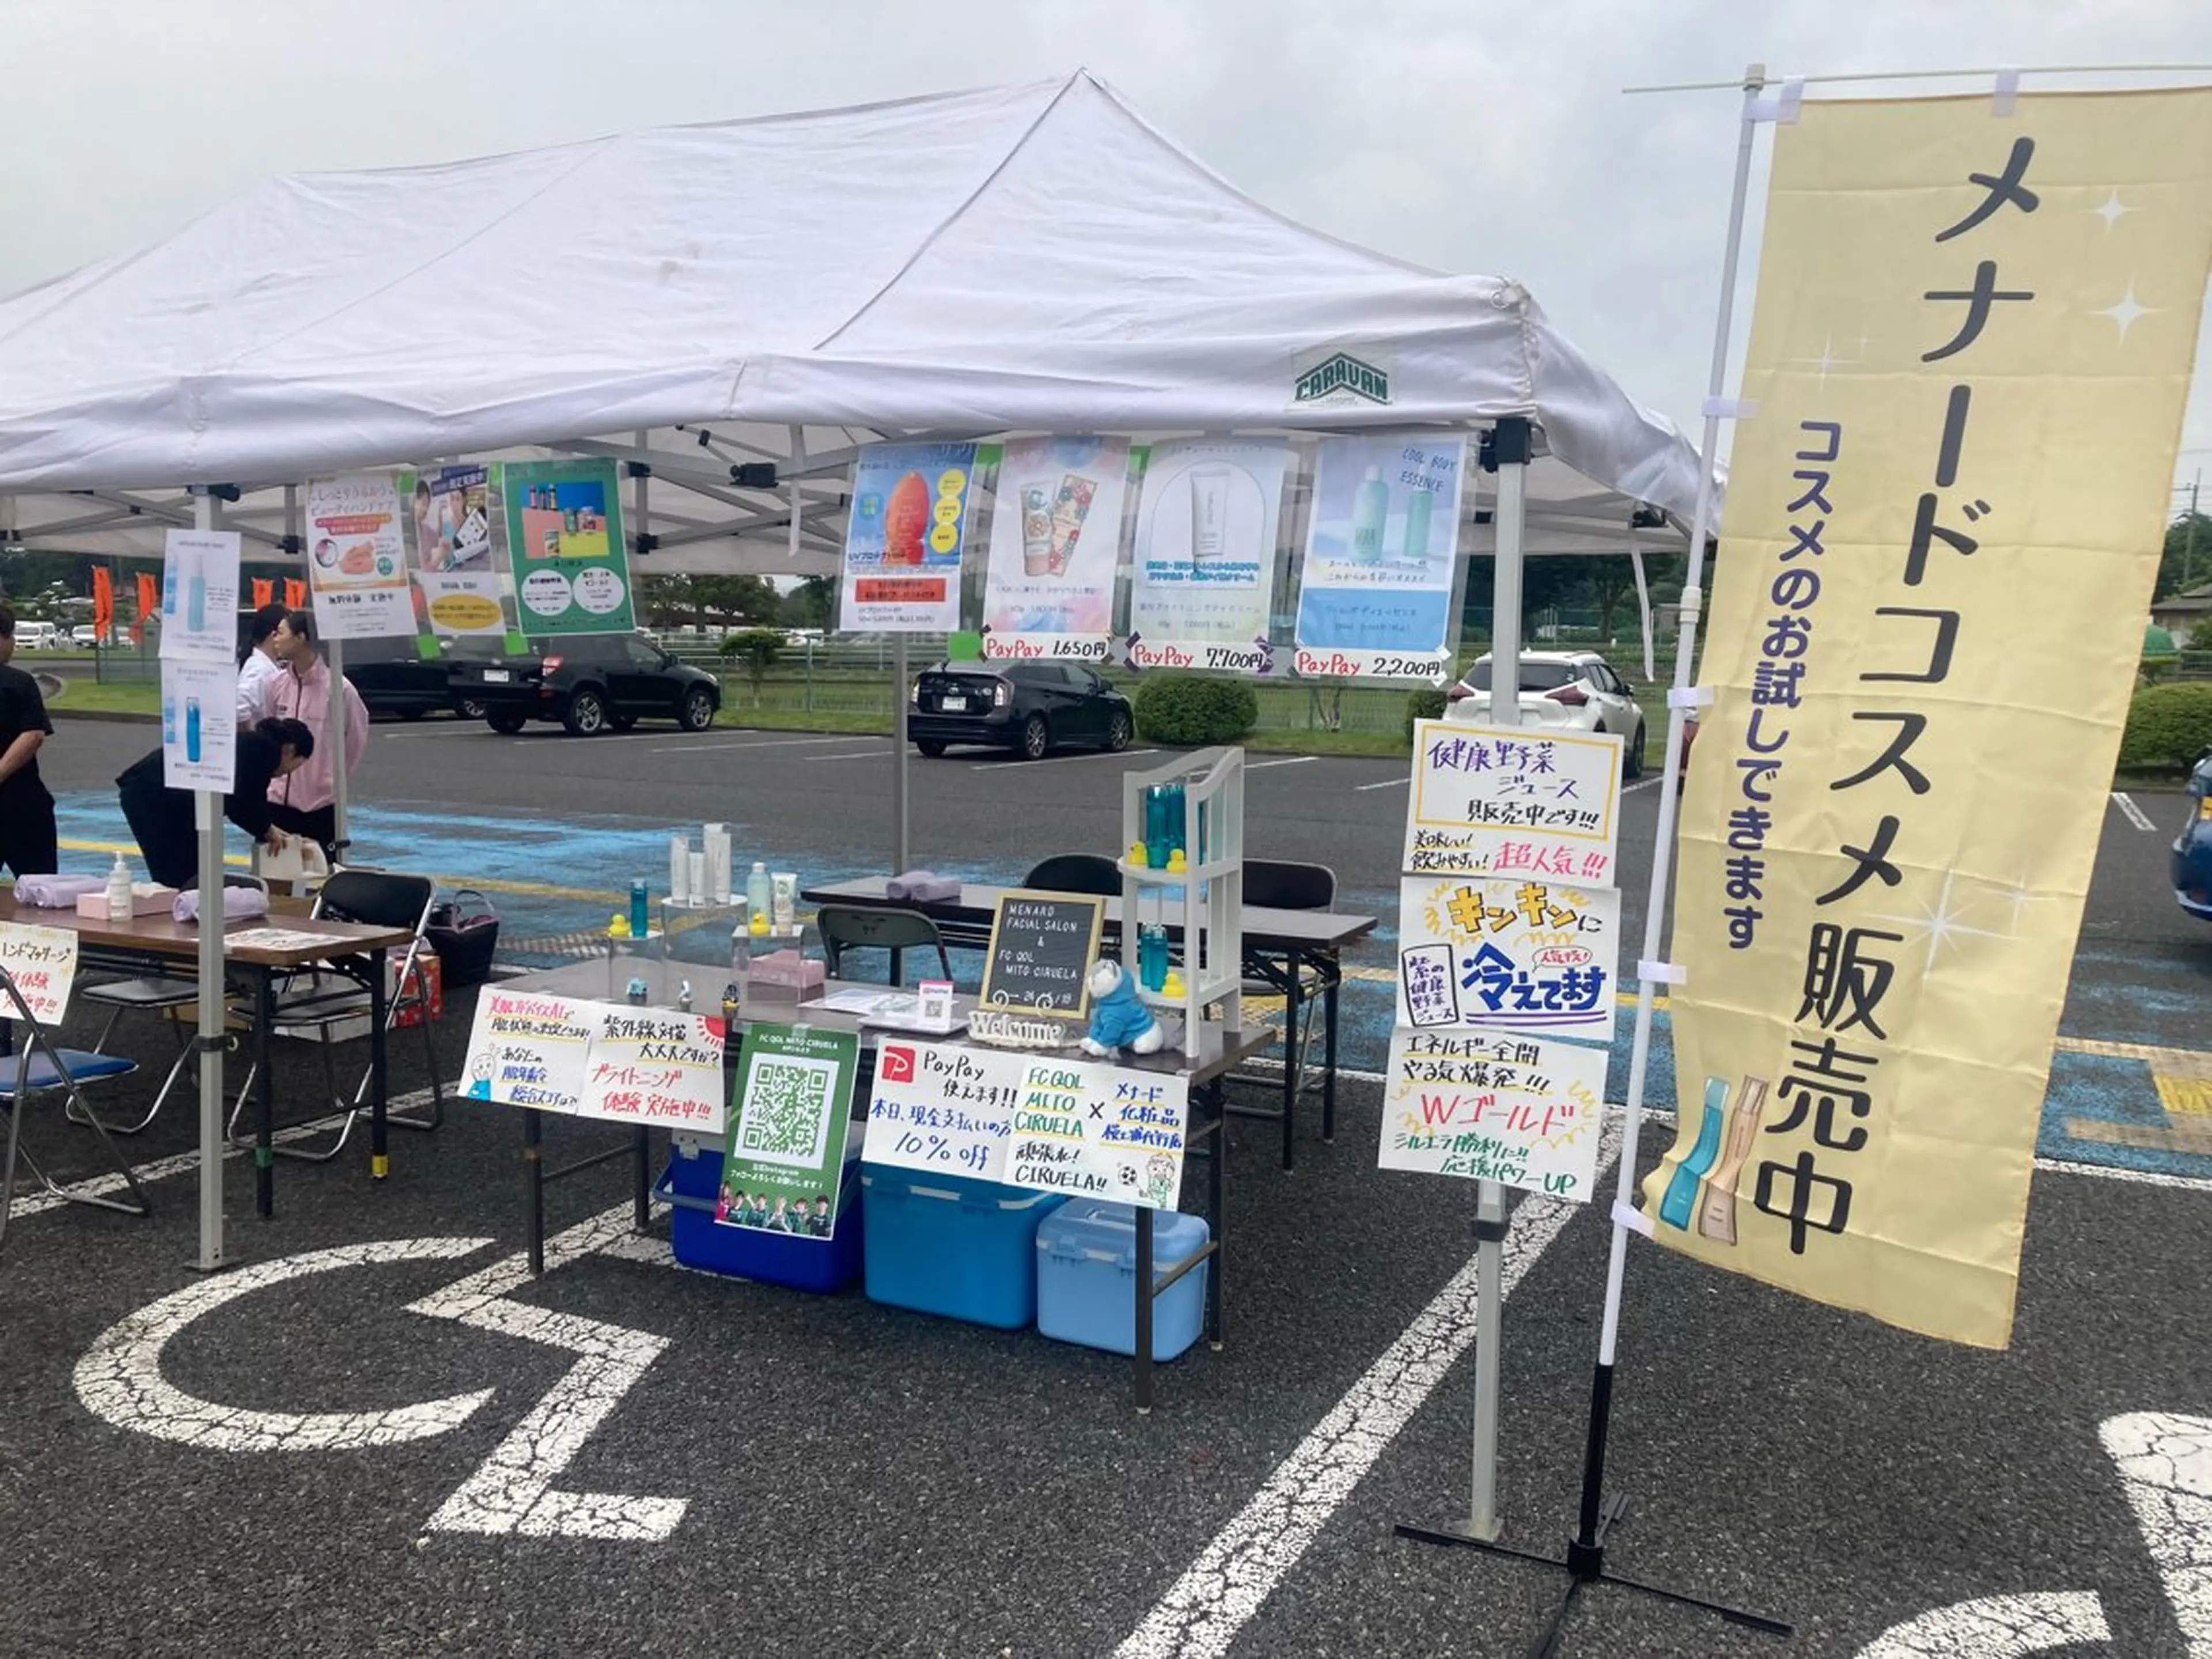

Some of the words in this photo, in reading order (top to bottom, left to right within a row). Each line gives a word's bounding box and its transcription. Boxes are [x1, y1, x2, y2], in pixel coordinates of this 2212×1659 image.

[1297, 359, 1387, 400] CARAVAN
[1402, 448, 1424, 465] COOL
[1430, 453, 1457, 472] BODY
[1400, 471, 1444, 491] ESSENCE
[986, 638, 1044, 658] PayPay
[1134, 643, 1194, 667] PayPay
[1298, 652, 1362, 676] PayPay
[1373, 657, 1441, 676] 2,200円
[1723, 421, 1842, 949] コスメのお試しできます
[1753, 137, 2040, 1255] メナードコスメ販売中
[1427, 738, 1557, 774] 健康野菜
[1497, 774, 1580, 800] ジュース
[1009, 903, 1055, 916] MENARD
[1446, 882, 1603, 934] キンキンに
[1006, 918, 1039, 930] FACIAL
[1044, 920, 1078, 933] SALON
[998, 949, 1012, 961] FC
[1005, 965, 1031, 976] MITO
[1032, 967, 1077, 980] CIRUELA
[1461, 942, 1607, 1012] 冷えてます
[967, 1011, 1063, 1042] Welcome
[1406, 1035, 1540, 1066] エネルギー全開
[592, 1063, 683, 1089] ブライトニング
[923, 1050, 985, 1082] PayPay
[1028, 1066, 1048, 1085] FC
[1050, 1070, 1085, 1090] QOL
[1025, 1092, 1076, 1112] MITO
[1115, 1081, 1164, 1103] メナード
[1014, 1111, 1084, 1138] CIRUELA
[1120, 1103, 1181, 1127] 化粧品
[1421, 1093, 1575, 1137] Wゴールド
